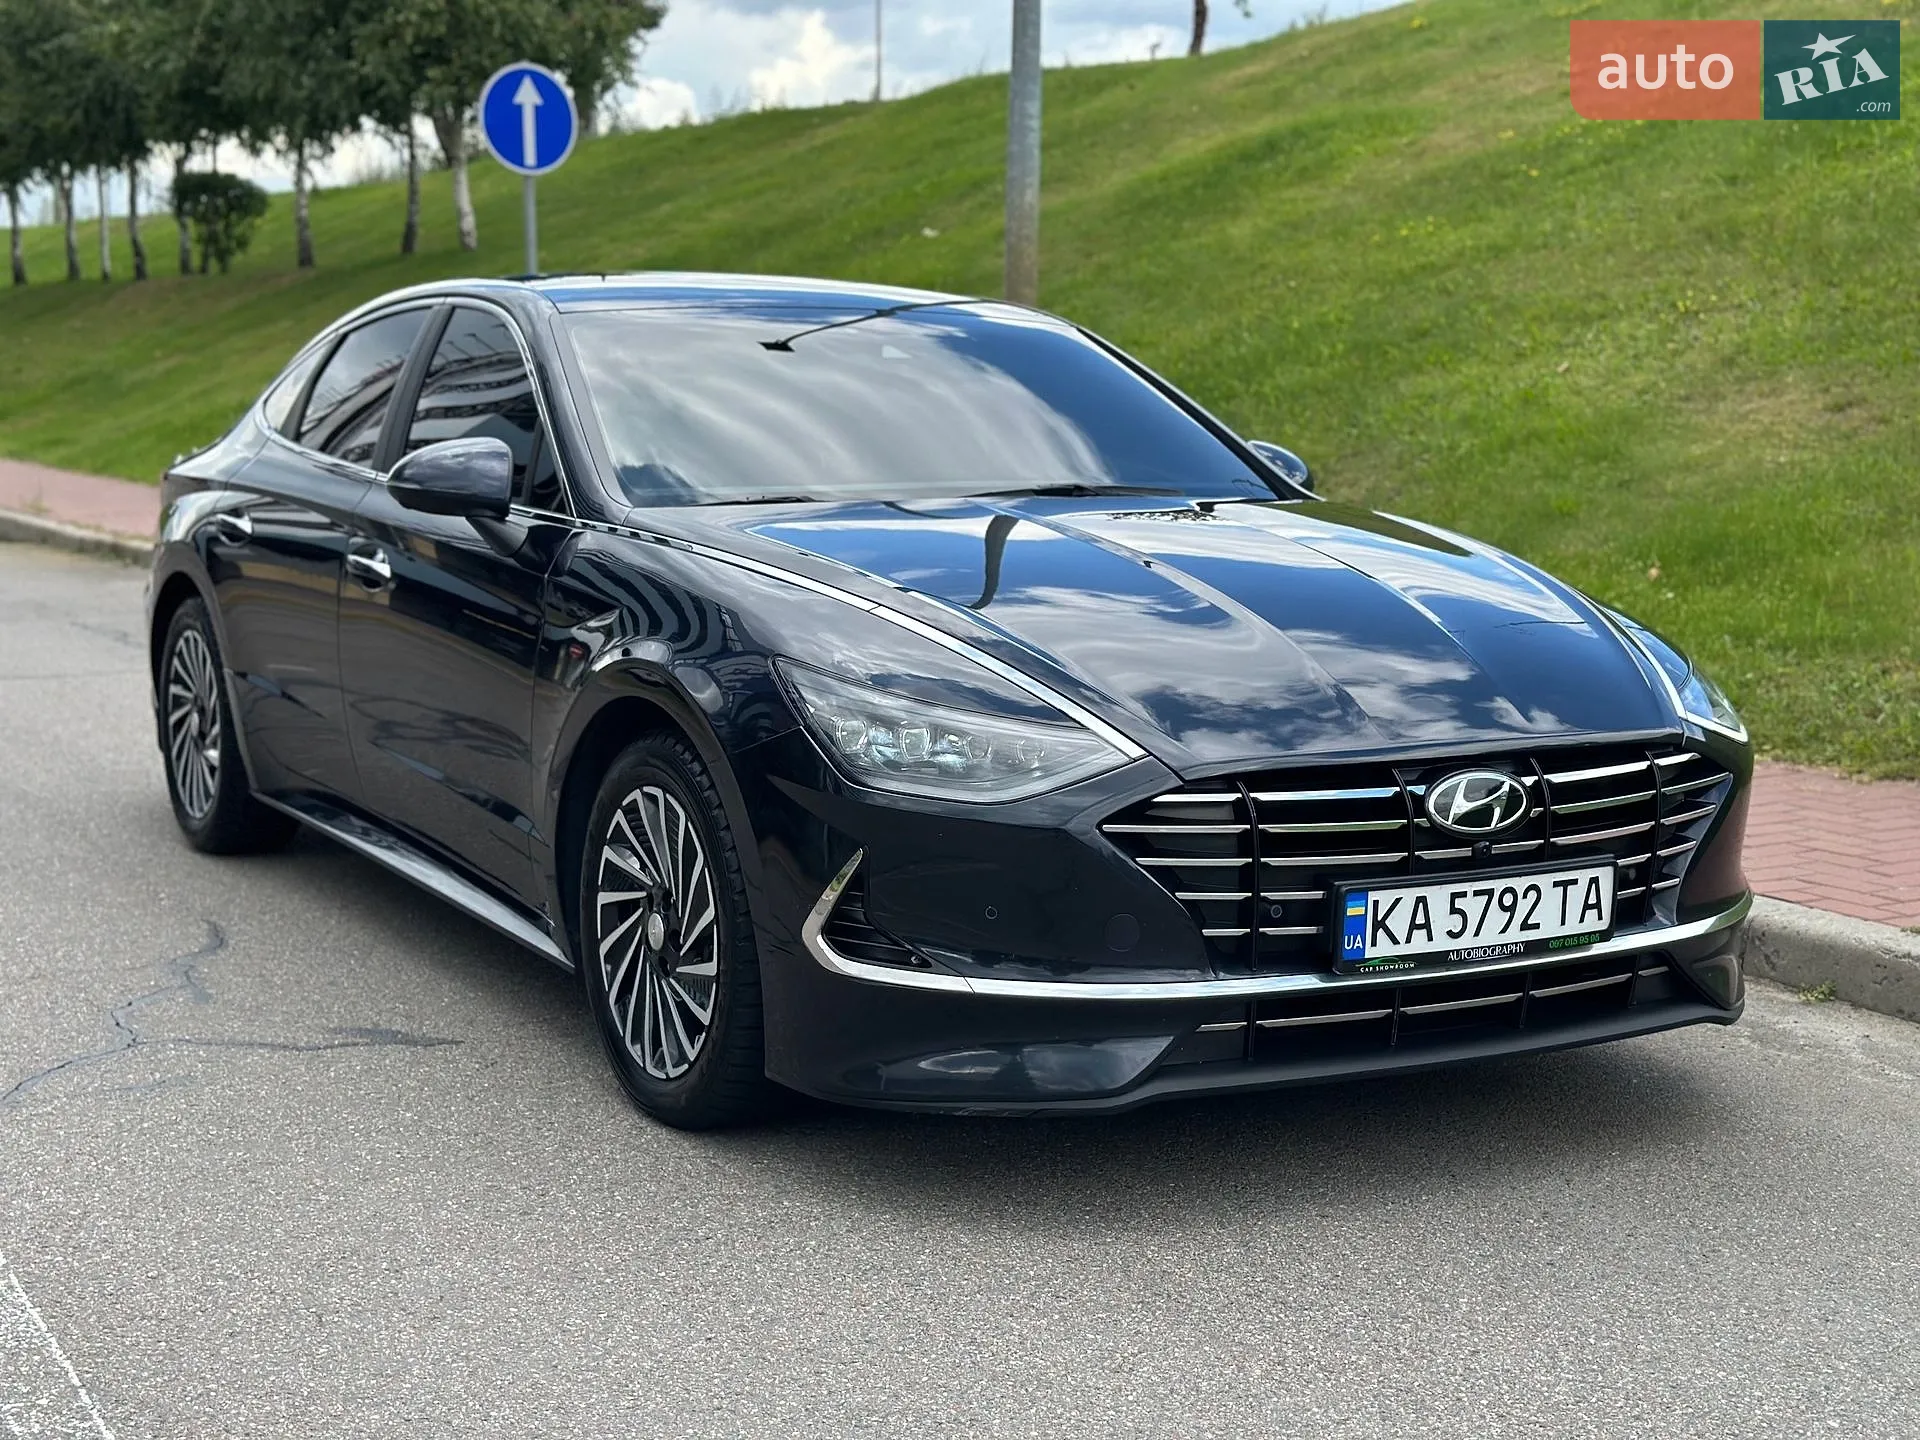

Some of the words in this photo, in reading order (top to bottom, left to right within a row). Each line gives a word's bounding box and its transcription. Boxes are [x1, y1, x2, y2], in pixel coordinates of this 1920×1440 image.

[1369, 895, 1434, 948] KA
[1445, 883, 1542, 939] 5792
[1552, 875, 1604, 927] TA
[1344, 934, 1363, 950] UA
[1549, 938, 1563, 949] 097
[1447, 942, 1526, 961] AUTOBIOGRAPHY
[1375, 963, 1415, 972] SHOWROOM
